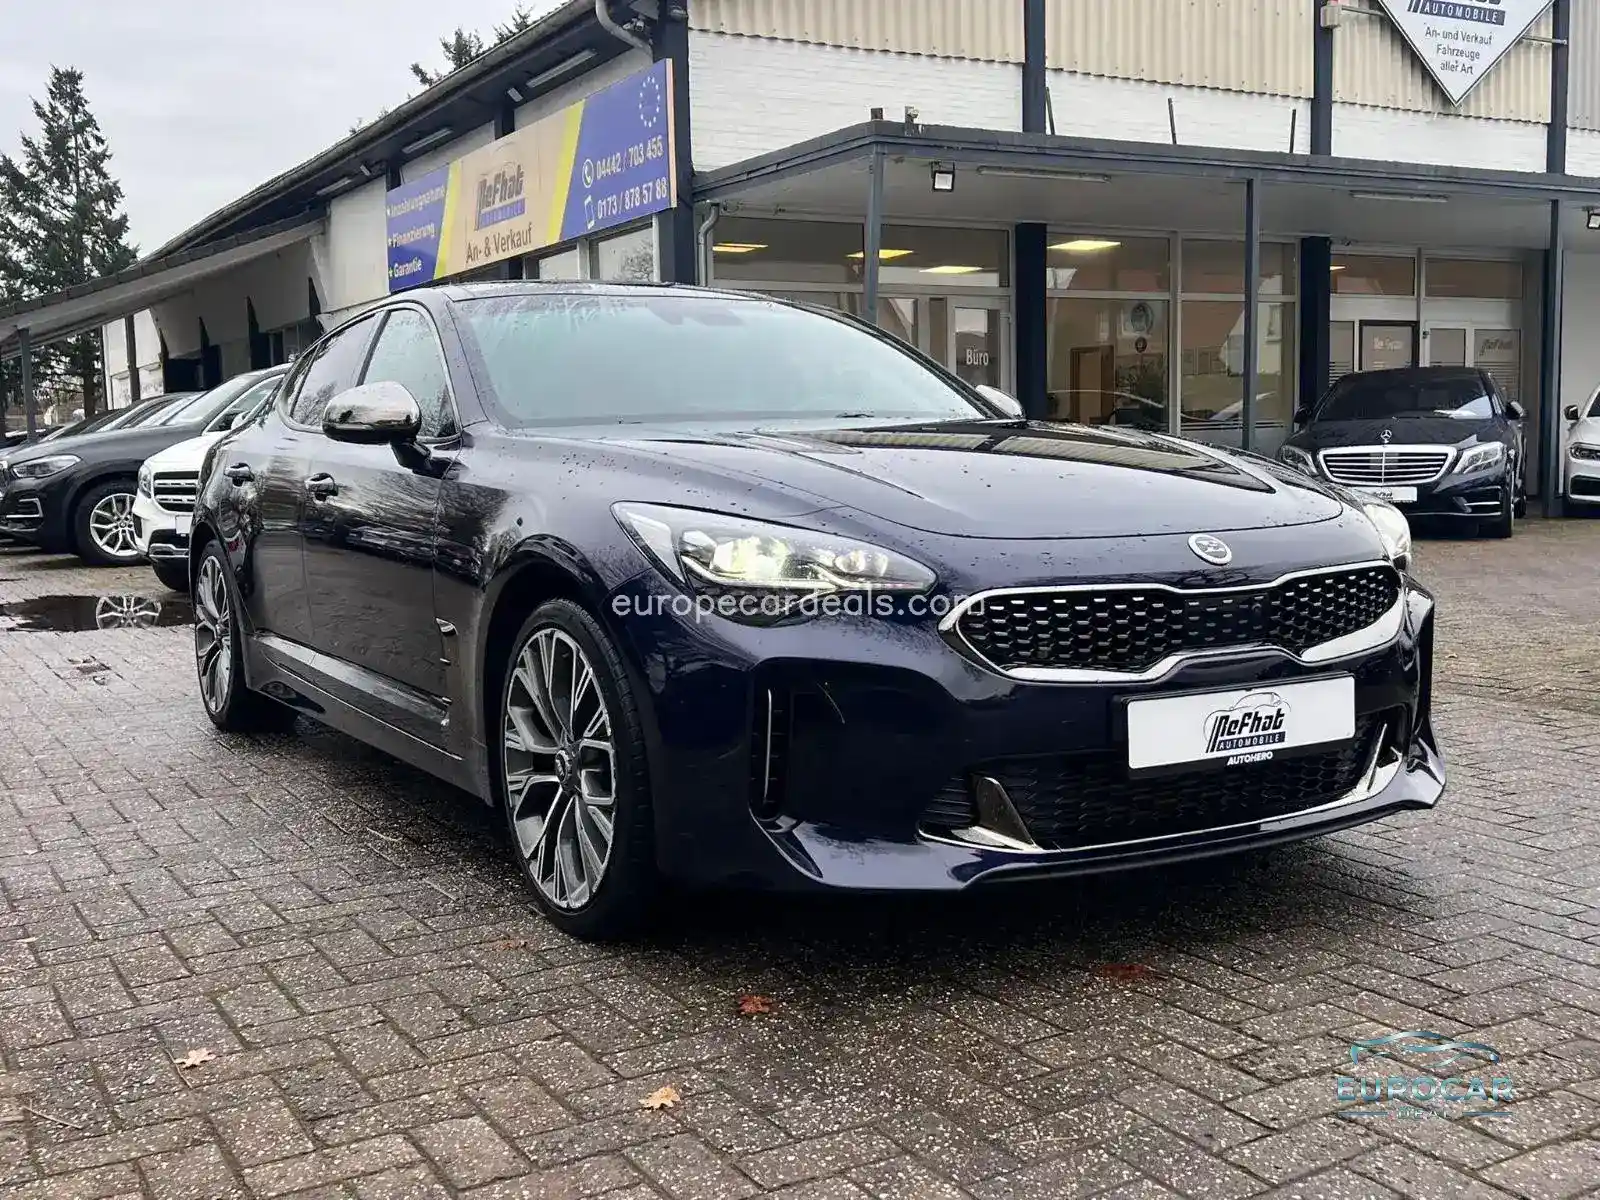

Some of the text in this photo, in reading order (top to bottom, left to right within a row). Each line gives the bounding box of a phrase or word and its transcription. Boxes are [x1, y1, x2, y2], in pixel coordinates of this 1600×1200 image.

[1424, 1, 1499, 22] AUTOMOBILE
[1425, 26, 1493, 45] An- und Verkauf
[1436, 44, 1480, 59] Fahrzeuge
[1440, 61, 1474, 74] aller Art
[596, 152, 621, 180] 04442
[628, 142, 645, 168] 703
[597, 194, 618, 220] 0173
[642, 182, 654, 205] 57
[655, 177, 668, 200] 88
[466, 242, 482, 263] An-
[493, 221, 533, 254] Verkauf
[966, 349, 989, 366] Büro
[1218, 733, 1281, 750] AUTOMOBILE
[1227, 751, 1274, 766] AUTOHERO
